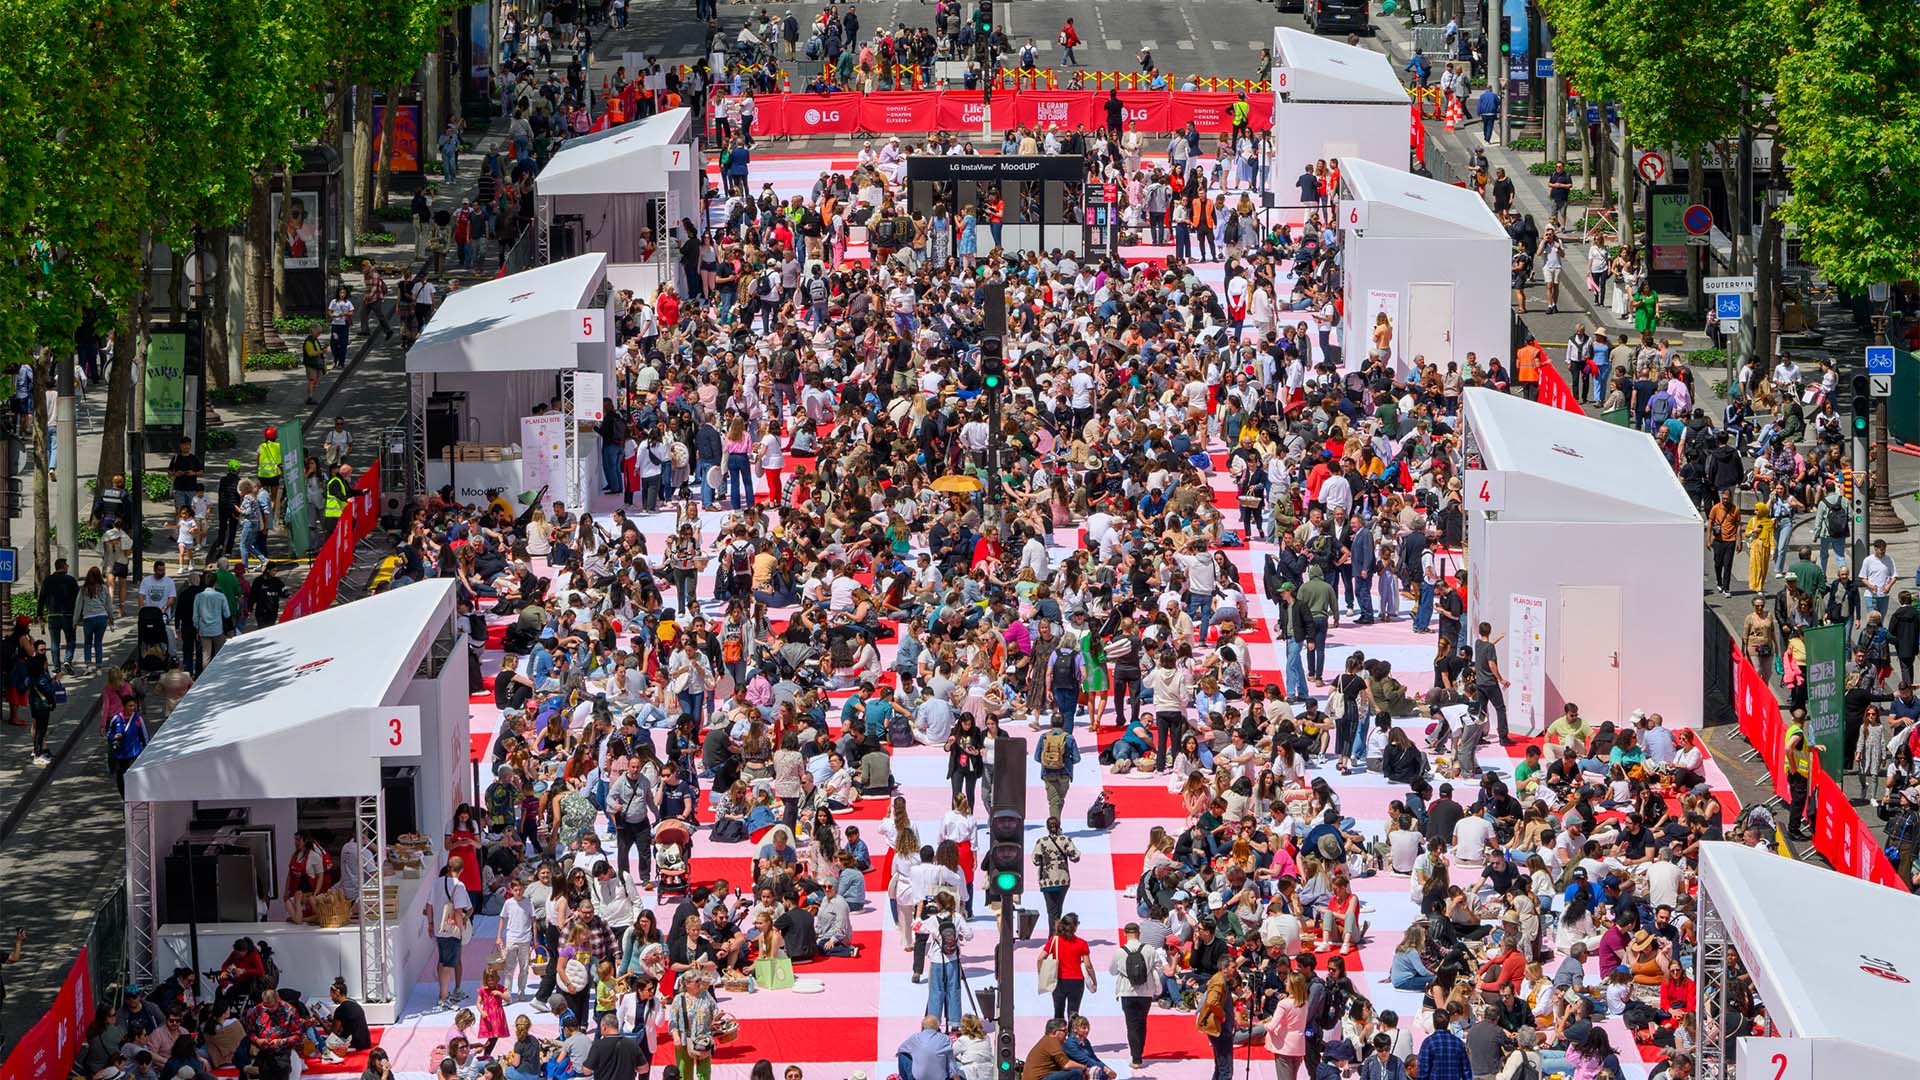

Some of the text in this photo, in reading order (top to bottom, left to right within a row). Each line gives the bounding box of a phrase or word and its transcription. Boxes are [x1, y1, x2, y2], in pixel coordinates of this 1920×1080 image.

[1280, 73, 1287, 87] 8
[822, 111, 839, 122] LG
[1130, 109, 1147, 120] LG
[672, 151, 680, 165] 7
[1350, 207, 1358, 223] 6
[583, 317, 592, 335] 5
[1480, 480, 1490, 502] 4
[389, 719, 402, 746] 3
[1771, 1053, 1788, 1080] 2
